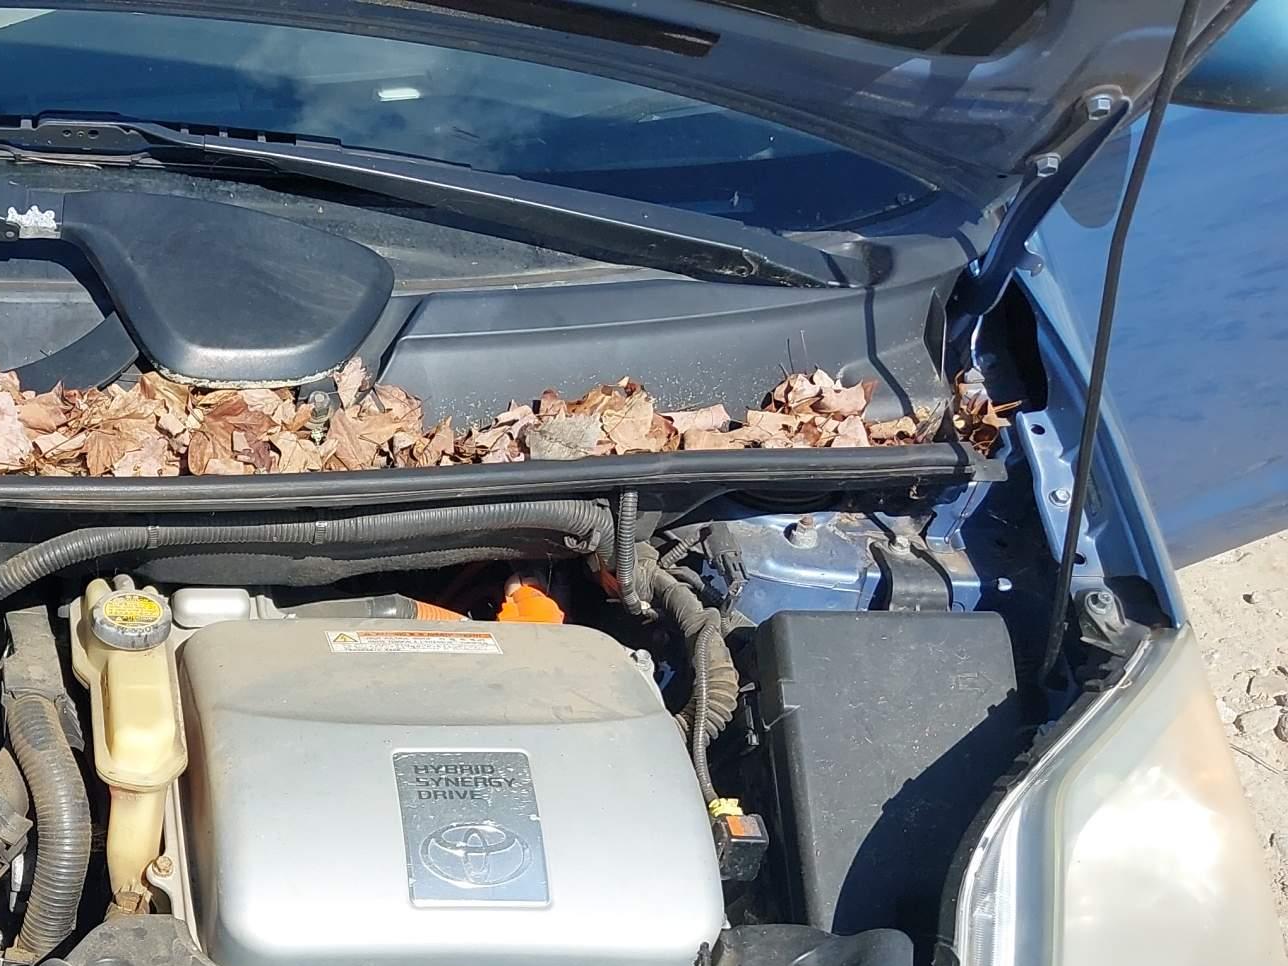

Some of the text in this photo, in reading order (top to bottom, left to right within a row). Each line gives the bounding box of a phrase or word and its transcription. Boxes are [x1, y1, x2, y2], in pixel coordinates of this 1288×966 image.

[414, 764, 495, 775] HYBRID
[415, 777, 516, 788] SYNERGY
[417, 790, 483, 800] DRIVE
